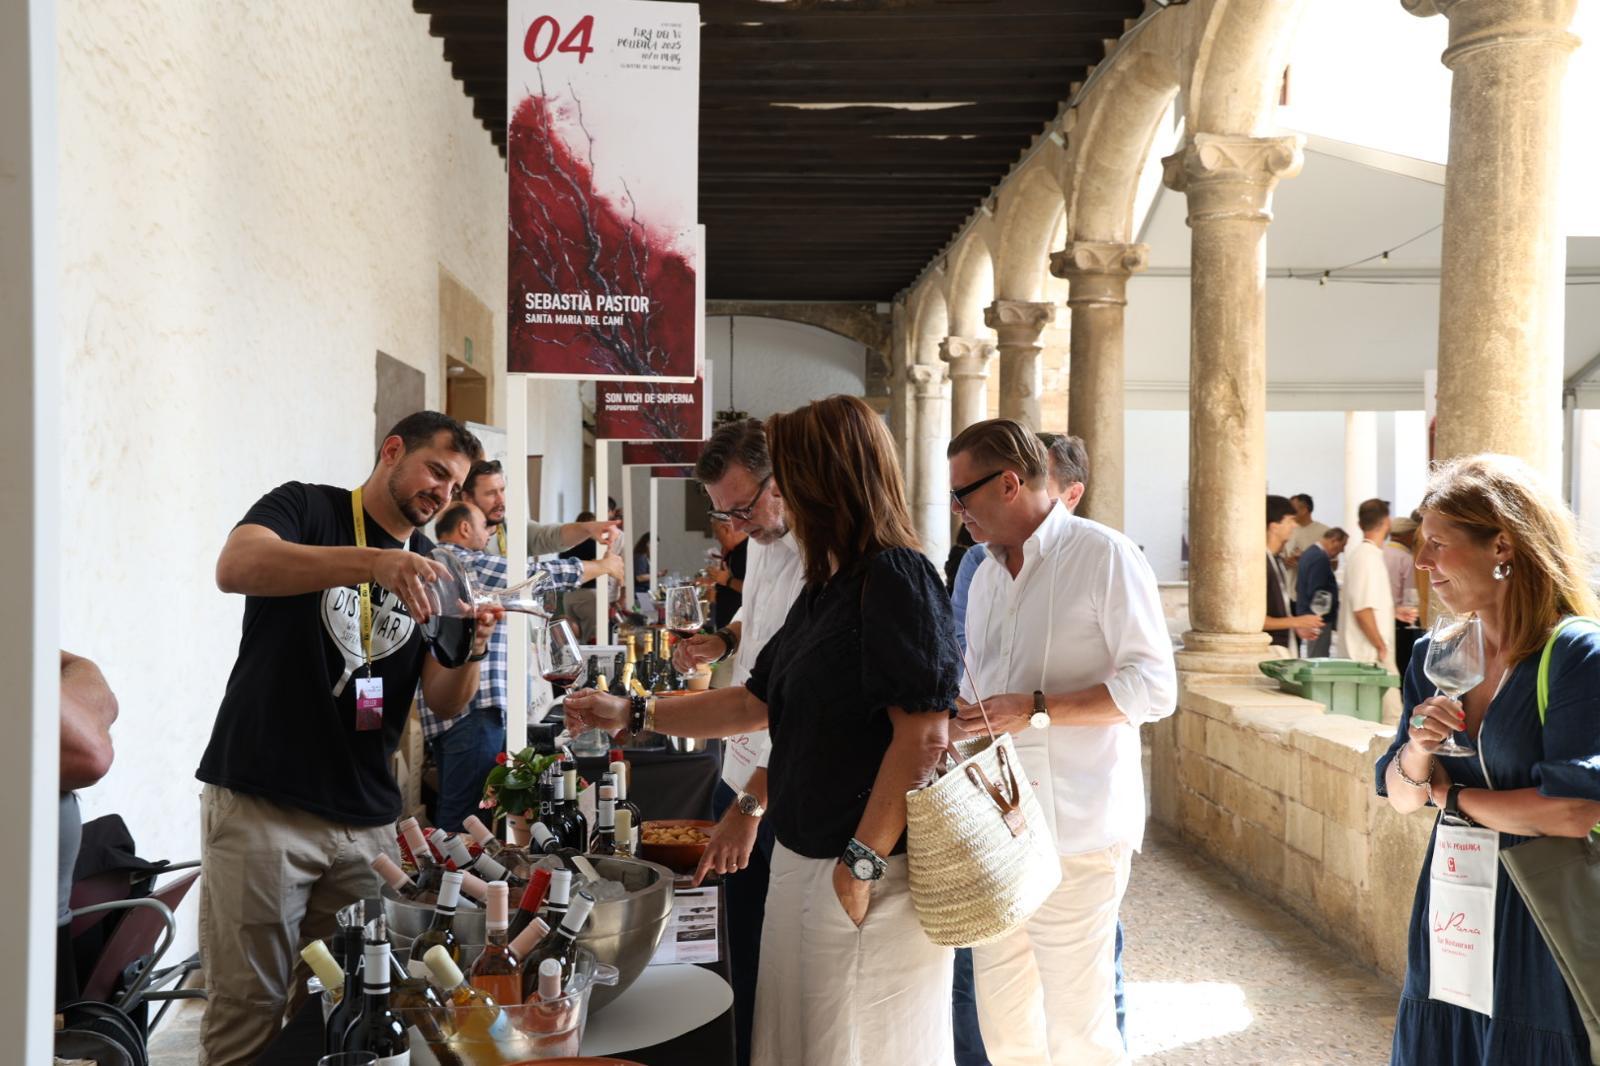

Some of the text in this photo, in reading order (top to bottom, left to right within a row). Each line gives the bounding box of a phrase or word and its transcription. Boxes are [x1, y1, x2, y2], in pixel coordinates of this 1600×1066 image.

[523, 15, 594, 64] 04
[661, 40, 681, 49] 2025
[525, 290, 649, 313] SEBASTIÀ PASTOR
[525, 313, 624, 326] SANTA MARIA DEL CAMÍ
[605, 392, 694, 404] SON VICH DE SUPERNA
